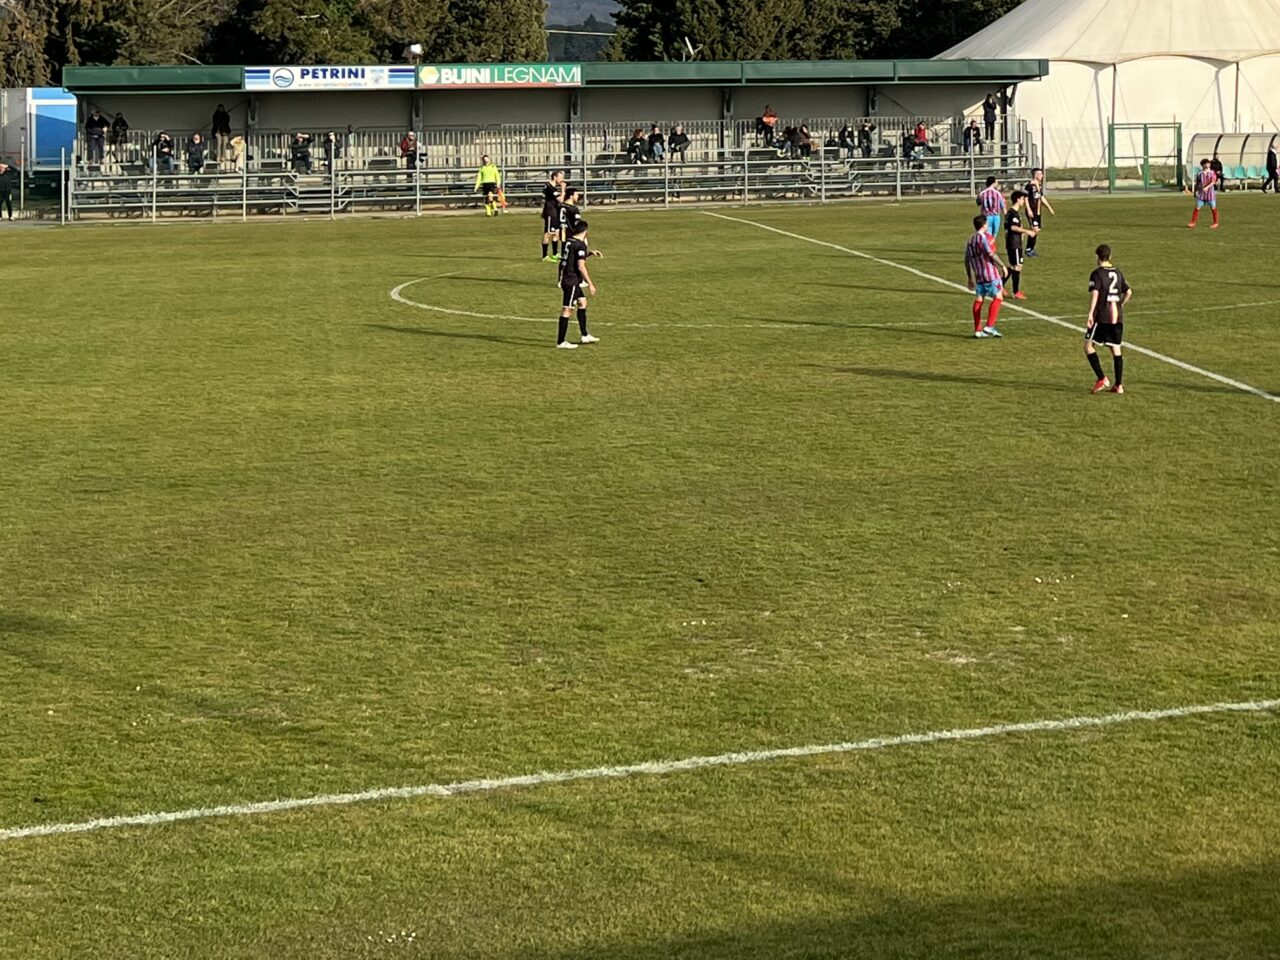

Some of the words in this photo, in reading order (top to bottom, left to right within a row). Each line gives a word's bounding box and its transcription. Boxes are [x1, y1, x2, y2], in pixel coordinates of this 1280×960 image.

[300, 67, 366, 80] PETRINI
[440, 68, 491, 84] BUINI
[494, 67, 581, 84] LEGNAMI
[559, 207, 567, 223] 6
[563, 241, 572, 260] 5
[1108, 271, 1119, 295] 2
